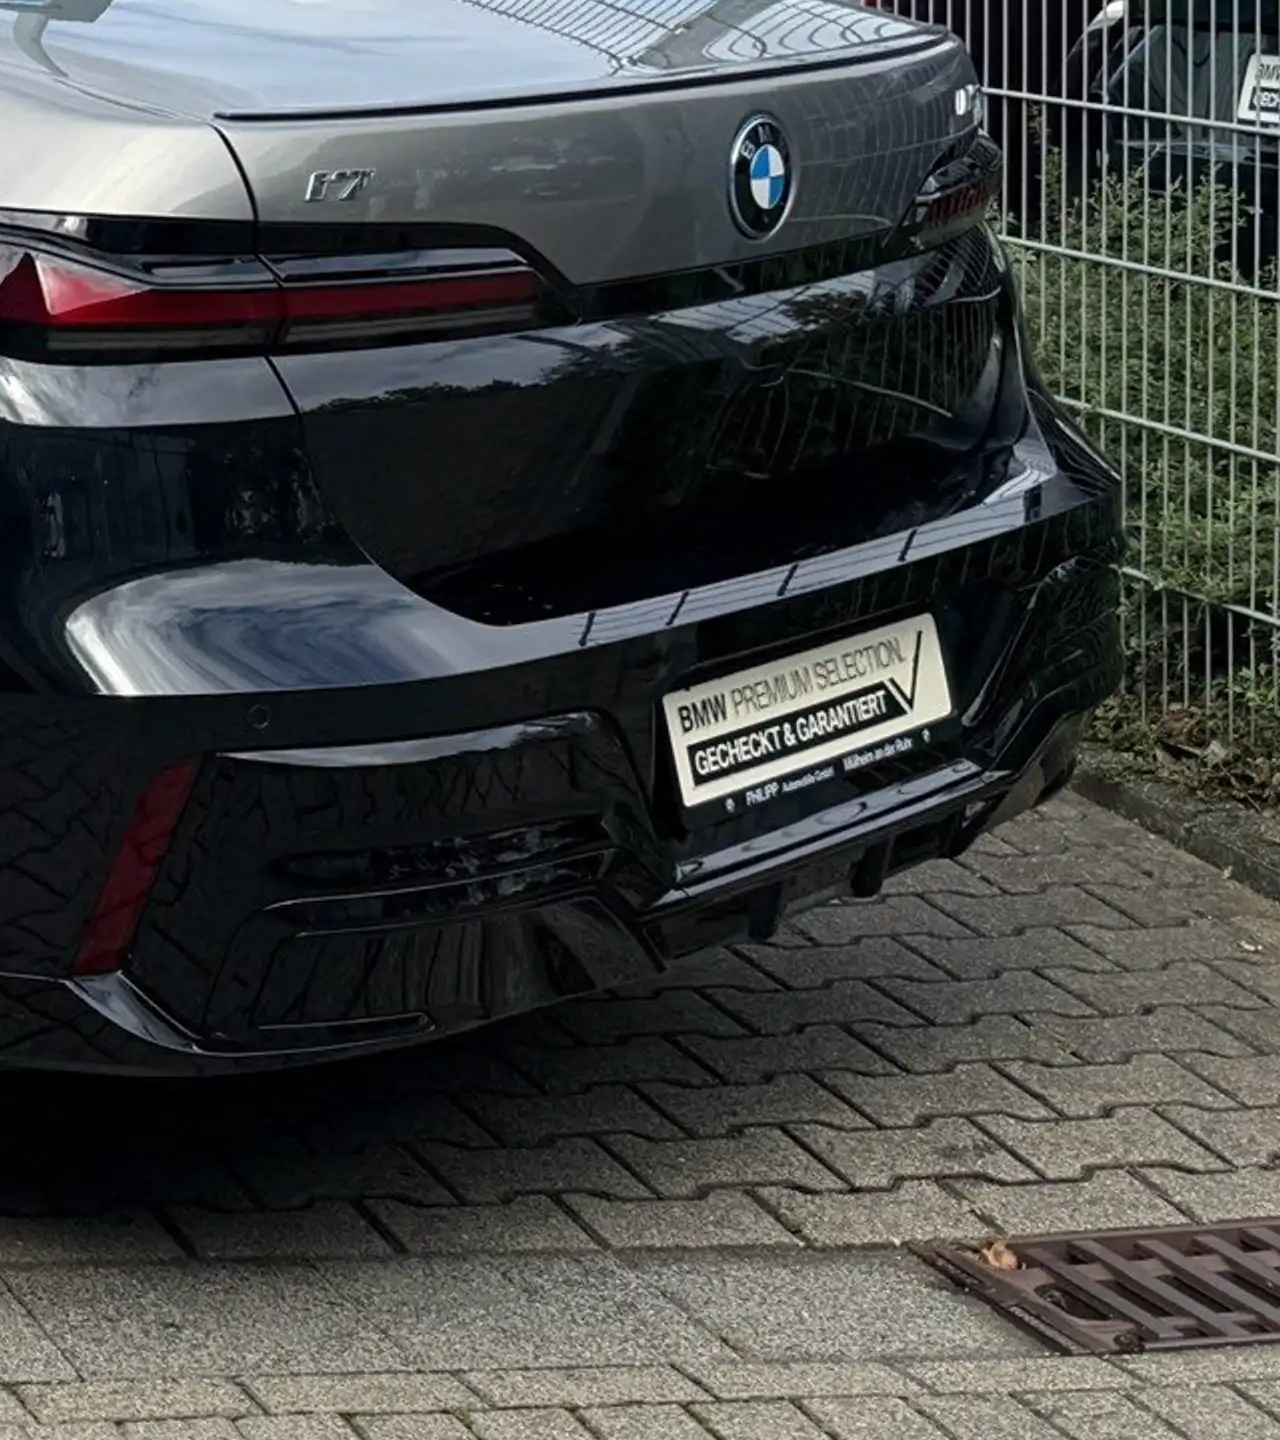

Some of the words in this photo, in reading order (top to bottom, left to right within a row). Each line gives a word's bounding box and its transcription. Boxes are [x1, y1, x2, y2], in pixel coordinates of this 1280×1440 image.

[678, 693, 728, 734] BMW
[731, 666, 813, 716] PREMIUM
[814, 637, 907, 689] SELECTION.
[694, 725, 782, 775] GECHECKT
[783, 721, 797, 745] &
[795, 690, 888, 742] GARANTIERT
